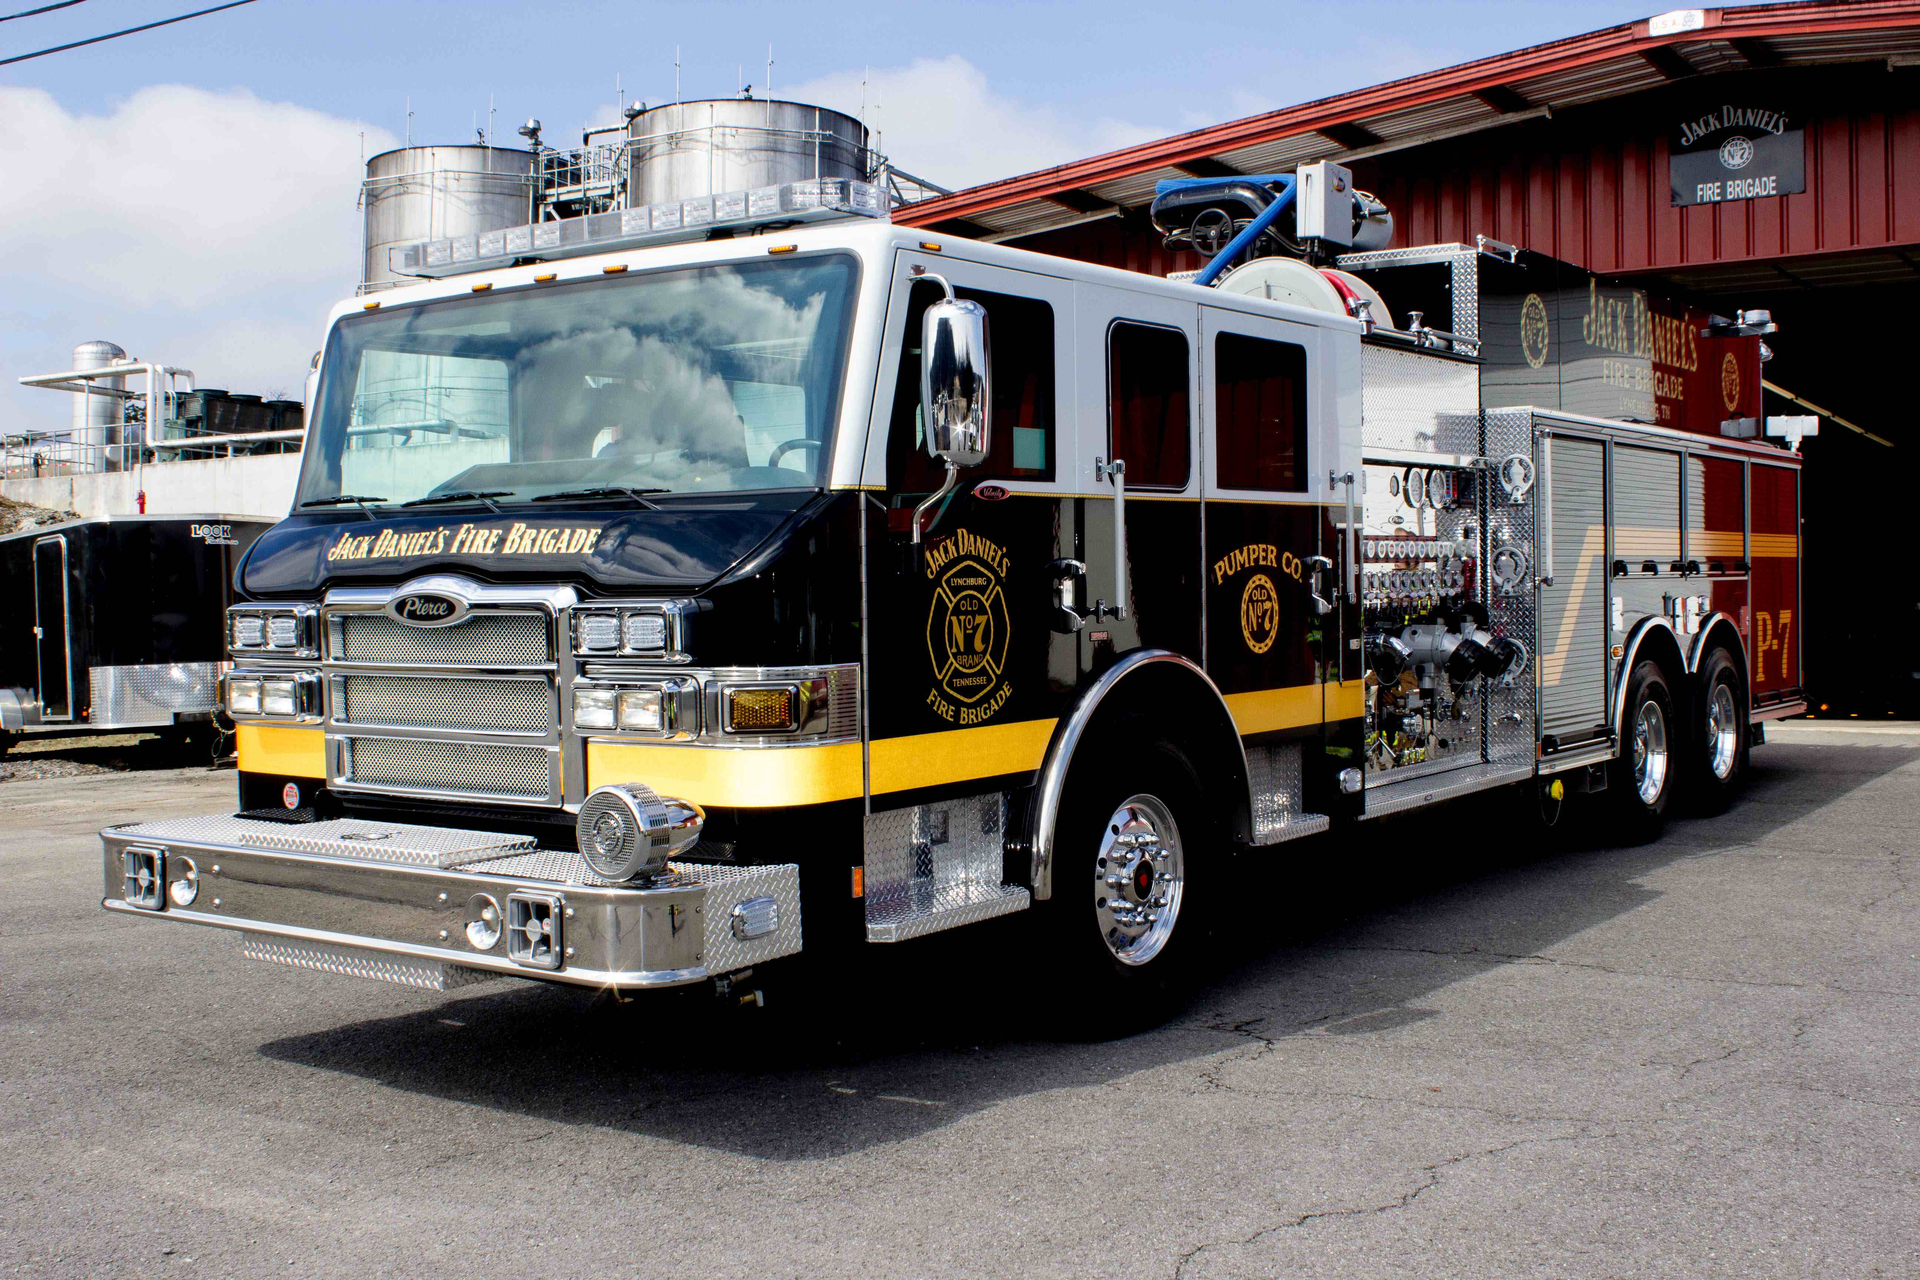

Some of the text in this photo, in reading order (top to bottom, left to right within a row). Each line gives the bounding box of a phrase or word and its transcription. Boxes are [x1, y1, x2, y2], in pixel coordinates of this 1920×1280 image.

[1680, 104, 1789, 146] JACK DANIEL'S
[1696, 175, 1778, 203] FIRE BRIGADE
[1582, 276, 1699, 373] JACK DANIEL'S
[1602, 359, 1685, 401] FIRE BRIGADE
[190, 524, 232, 538] LOOK
[327, 522, 602, 562] JACK DANIEL'S FIRE BRIGADE
[925, 527, 1011, 579] JACK DANIEL'S
[1213, 543, 1303, 586] PUMPER CO.
[950, 577, 987, 586] LYNCHBURG
[1251, 587, 1268, 601] OLD
[401, 596, 450, 619] Pierce
[959, 597, 979, 611] OLD
[956, 653, 984, 668] BRAND
[1755, 609, 1793, 682] P-7
[952, 675, 988, 688] TENNESSEE
[926, 680, 1014, 725] FIRE BRIGADE
